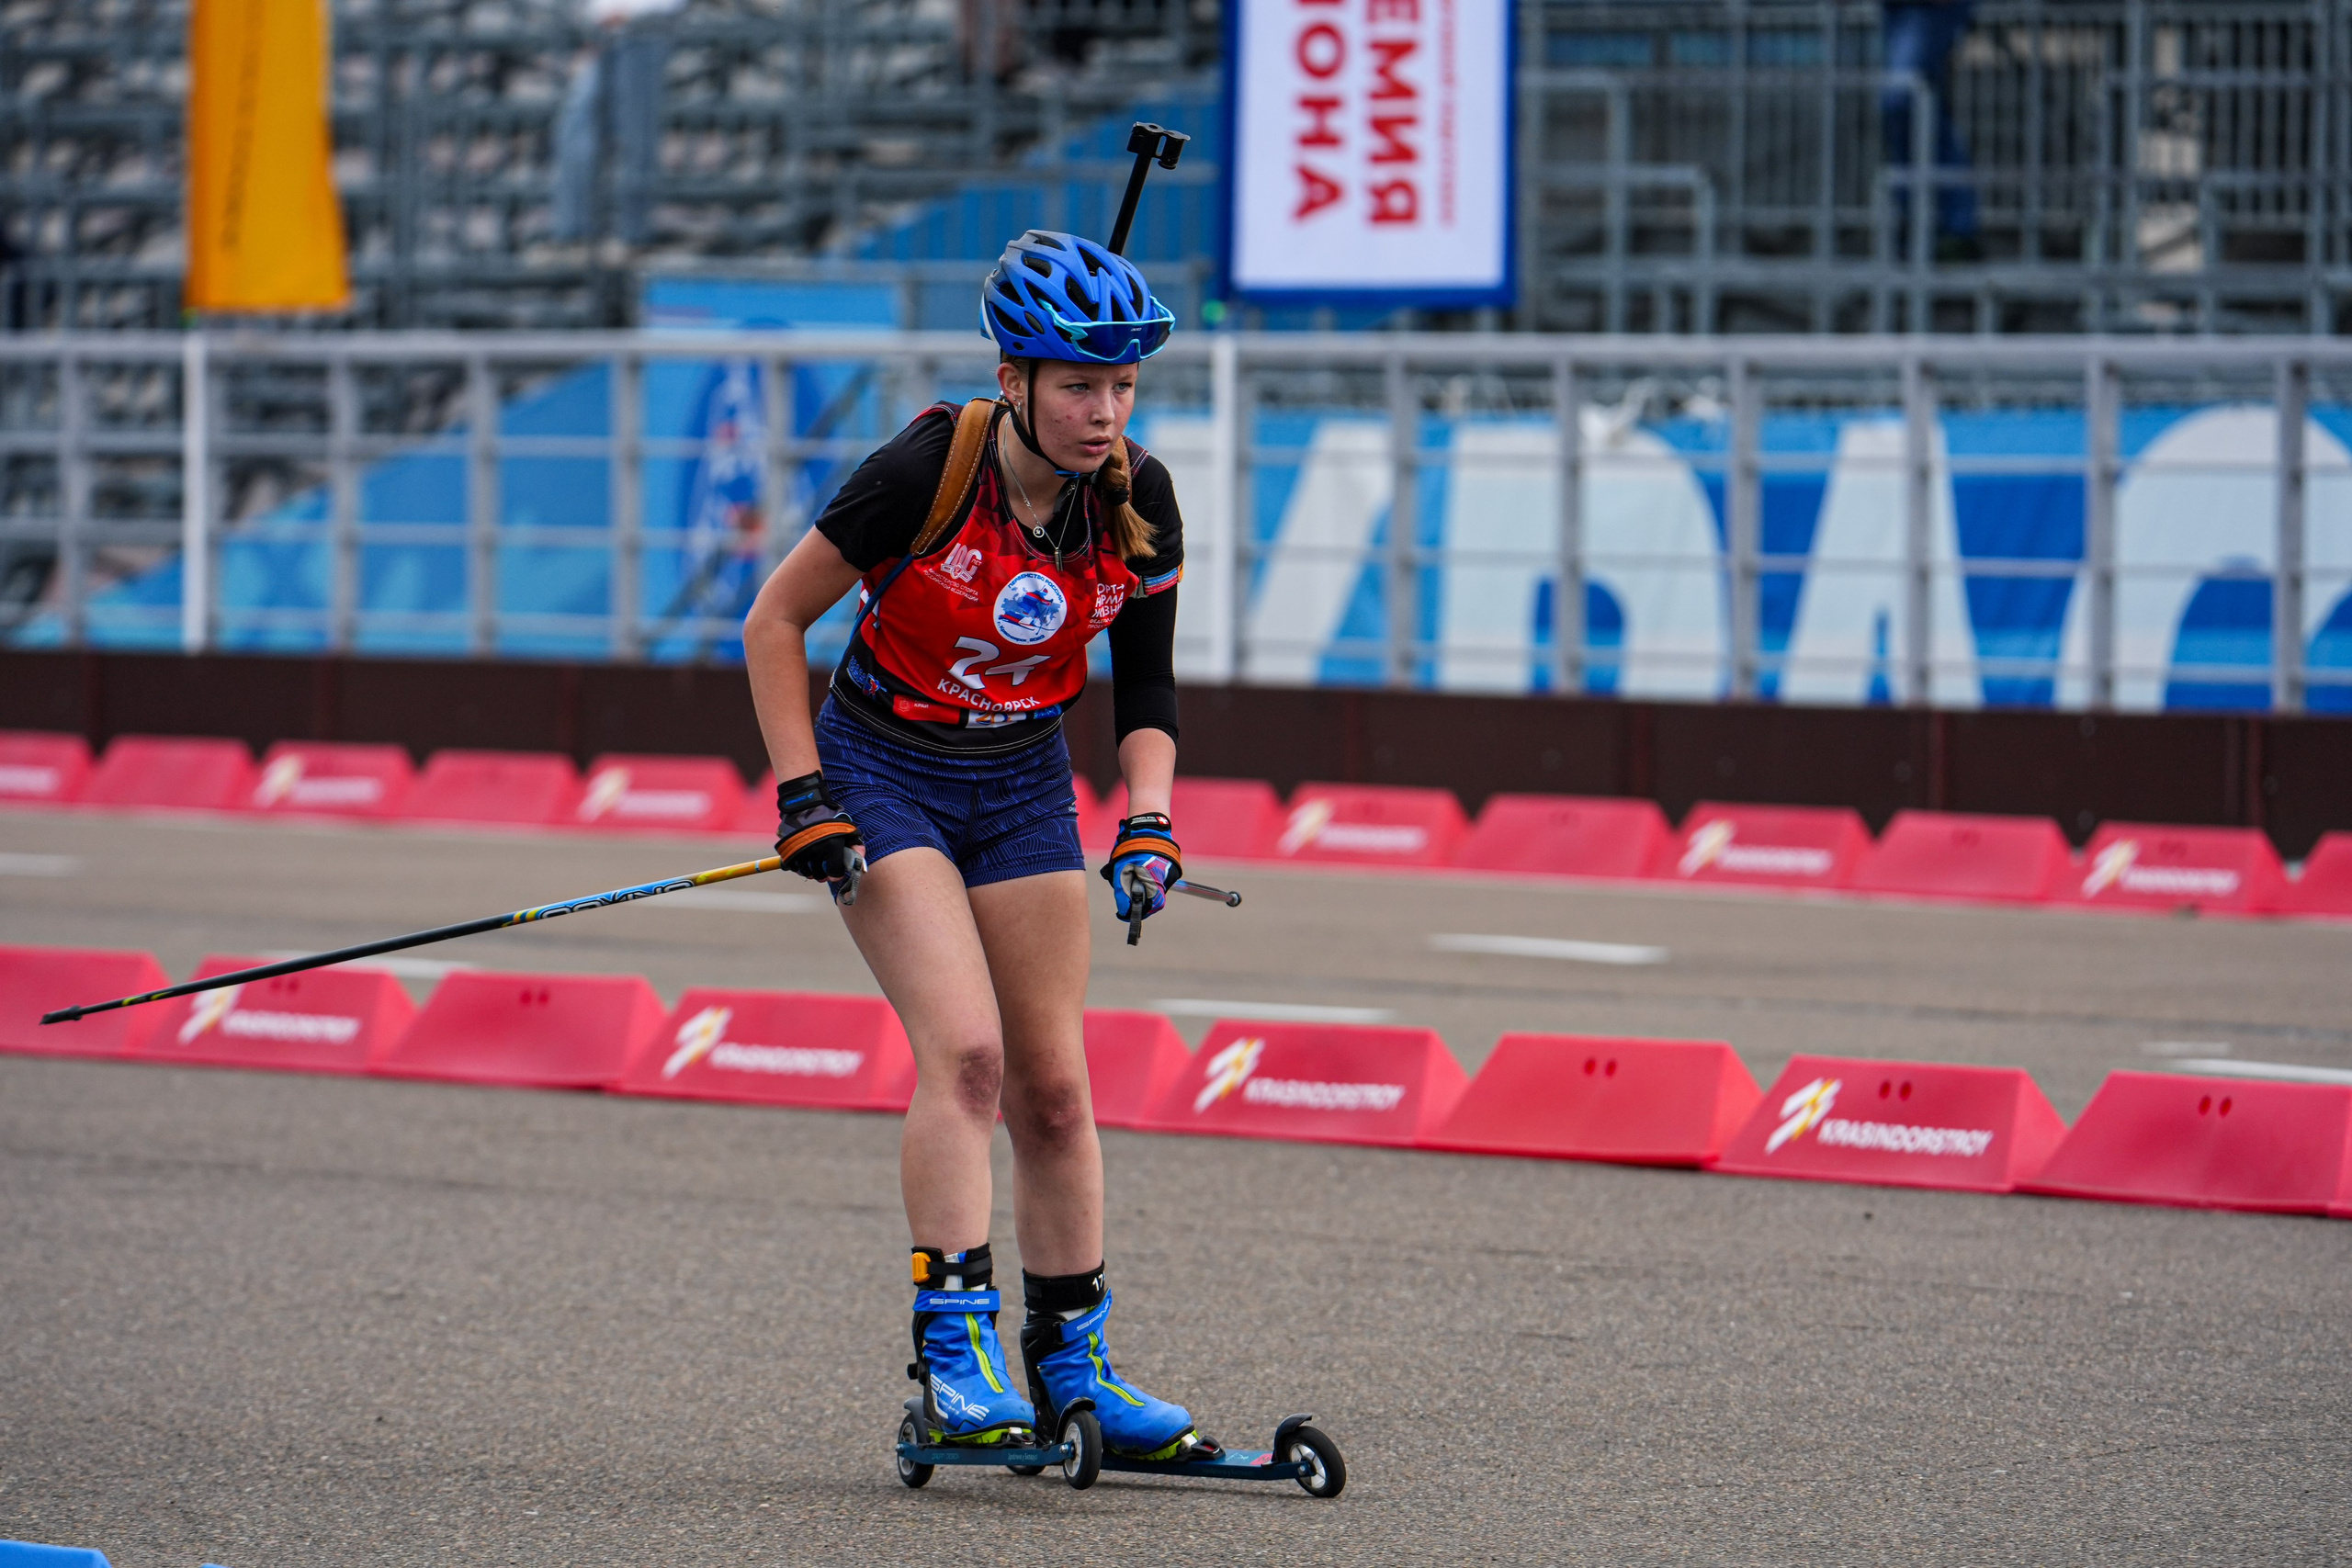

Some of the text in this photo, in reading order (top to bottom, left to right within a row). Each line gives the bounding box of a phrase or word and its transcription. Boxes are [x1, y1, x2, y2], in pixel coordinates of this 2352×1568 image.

[1294, 0, 1344, 223] ОНА
[947, 636, 1052, 689] 24
[937, 678, 1041, 713] КРАСНОЯРСК
[929, 1297, 990, 1305] SPINE
[1076, 1298, 1110, 1332] SPIN
[930, 1372, 990, 1422] SPINE
